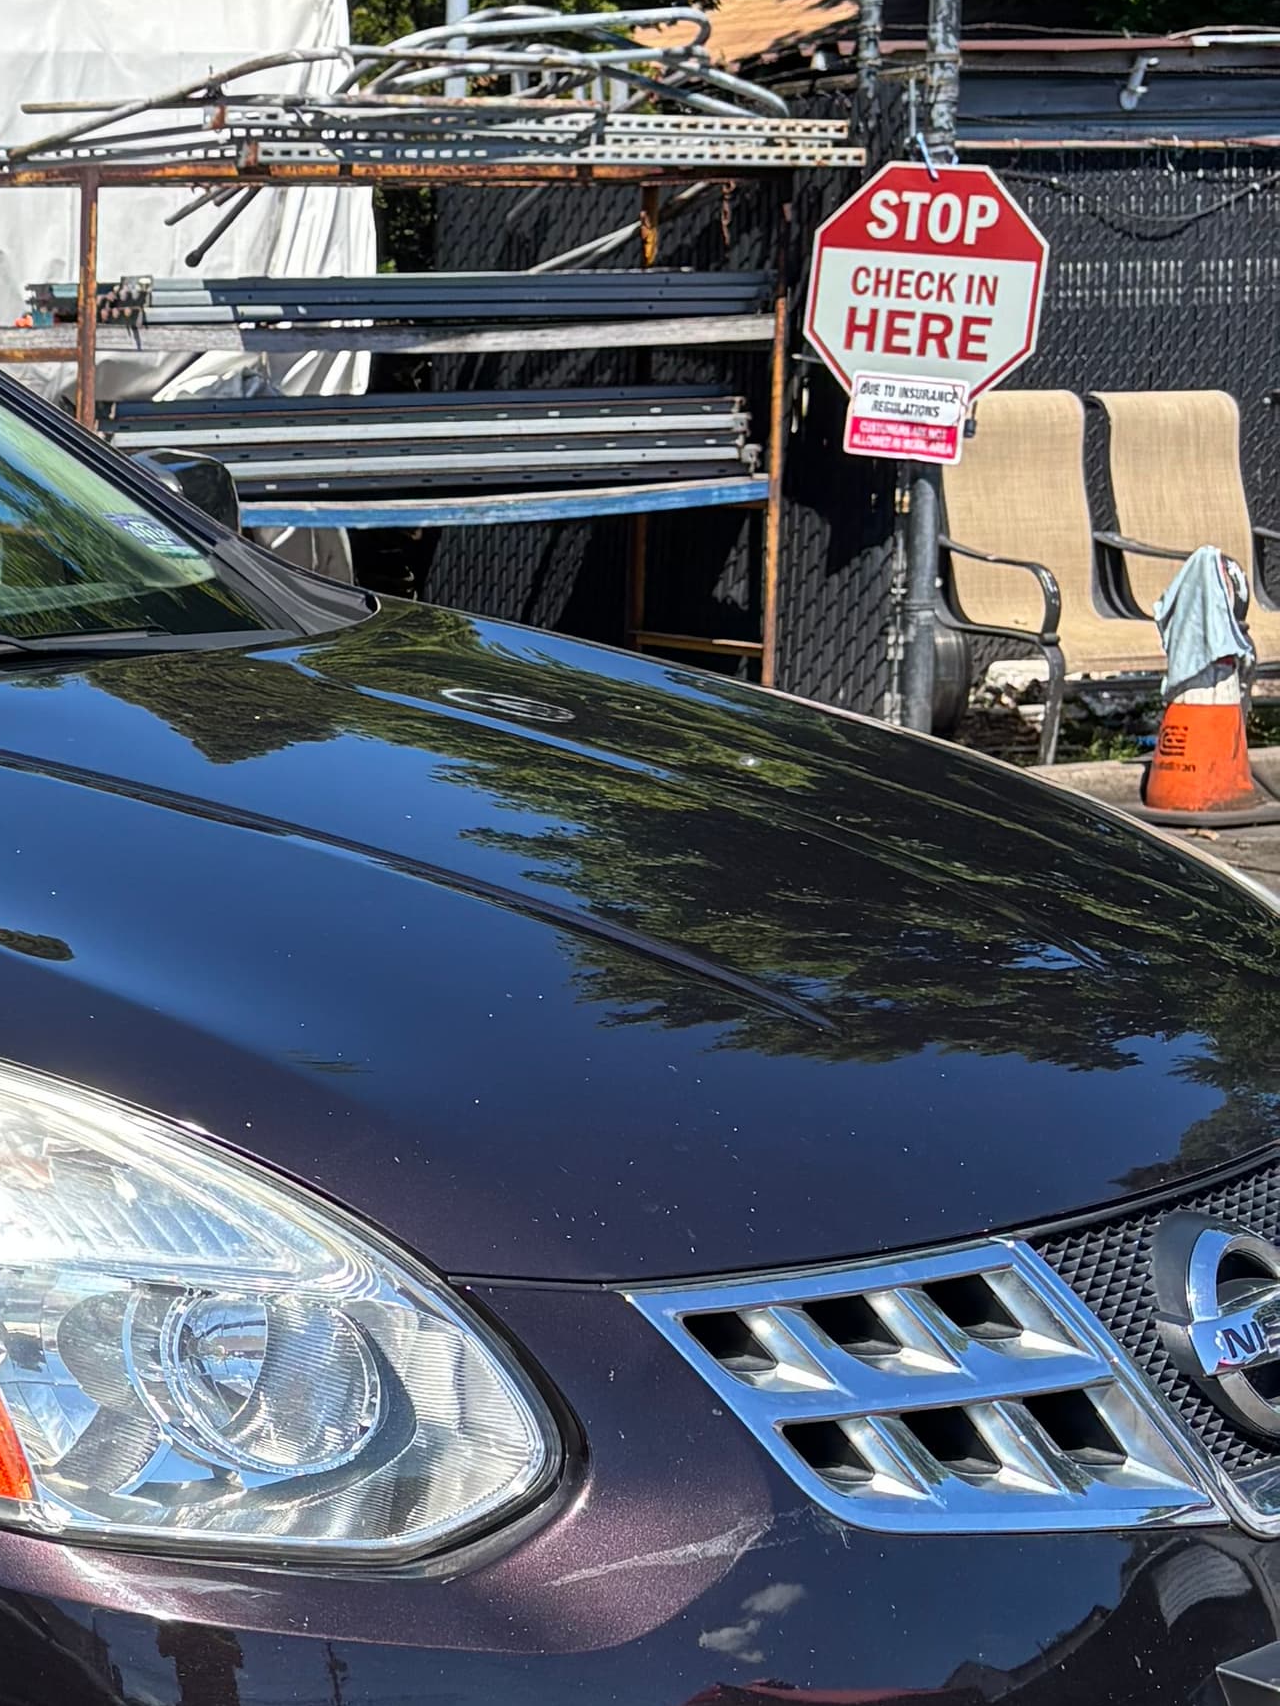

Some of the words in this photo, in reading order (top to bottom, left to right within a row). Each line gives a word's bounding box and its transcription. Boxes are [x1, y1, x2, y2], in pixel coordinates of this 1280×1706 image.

[866, 190, 999, 245] STOP
[851, 265, 956, 303] CHECK
[964, 274, 998, 306] IN
[843, 306, 993, 362] HERE
[860, 381, 880, 396] DUE
[884, 384, 895, 397] TO
[899, 387, 957, 404] INSURANCE
[871, 400, 940, 418] REGULATIONS
